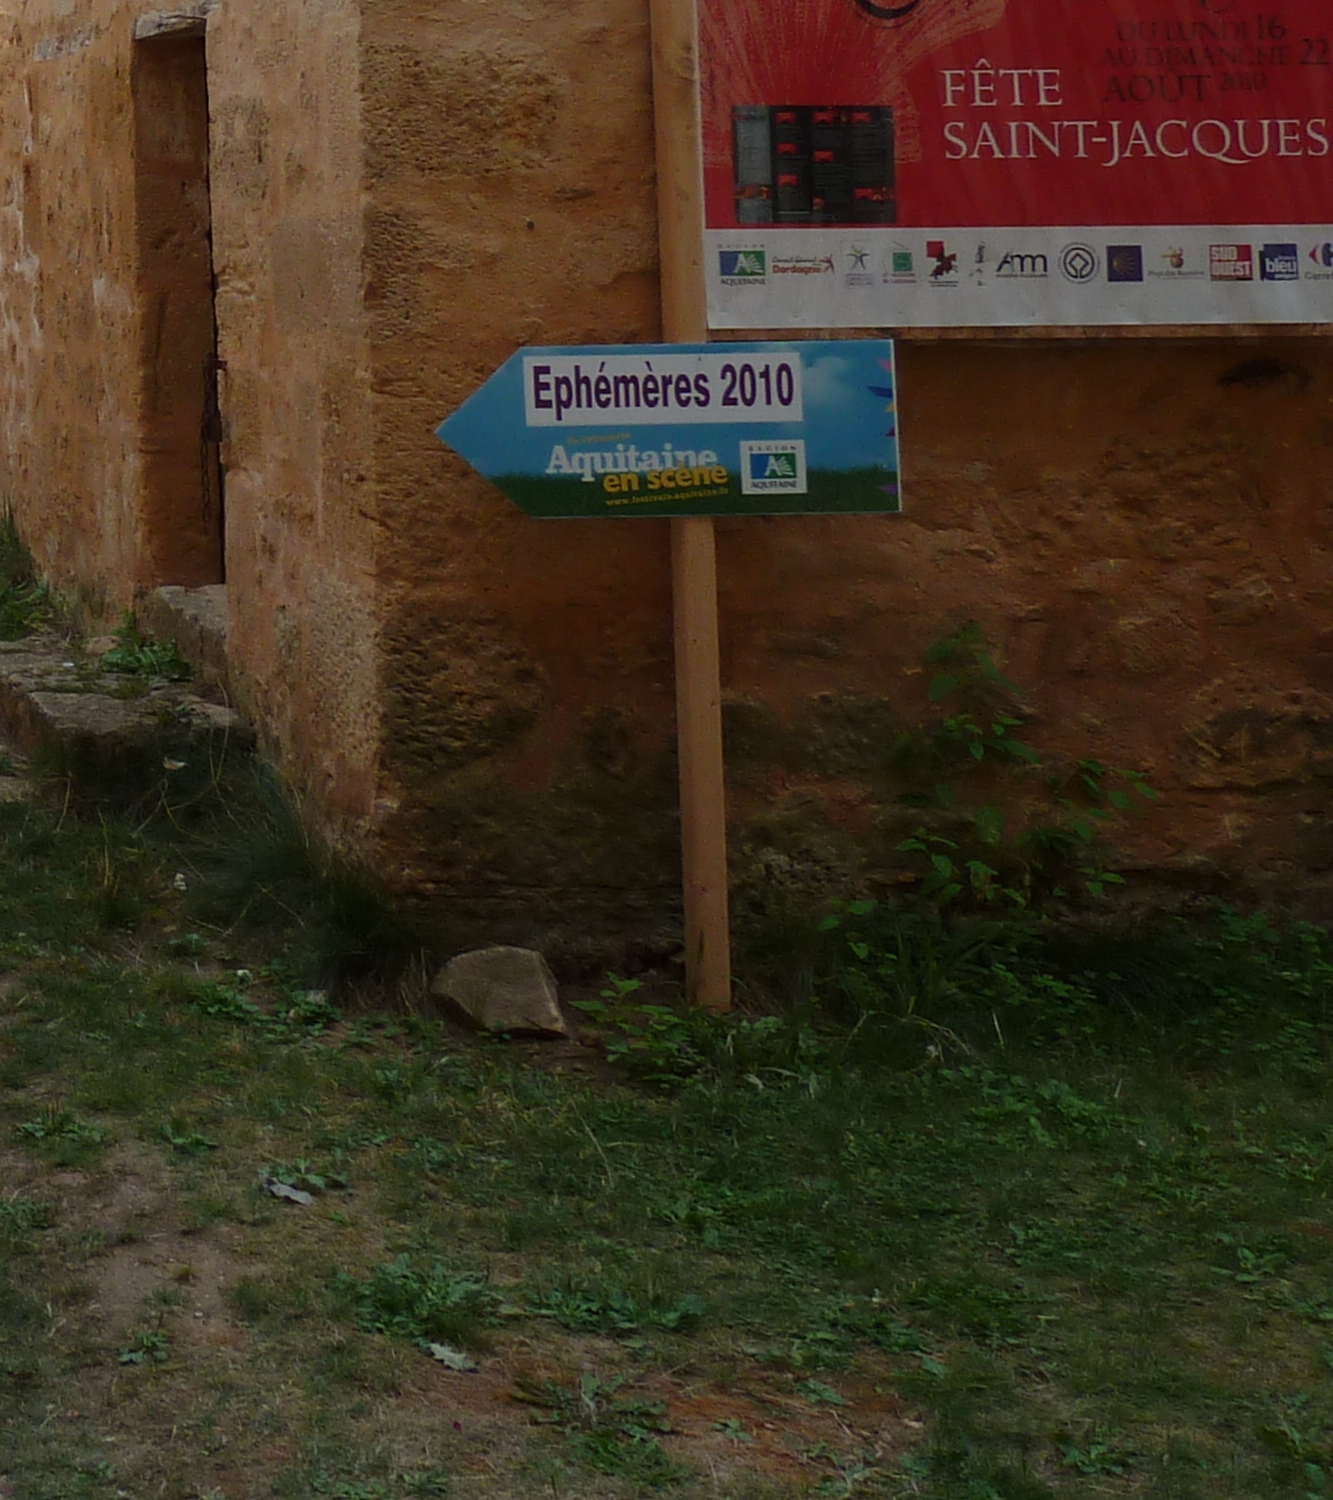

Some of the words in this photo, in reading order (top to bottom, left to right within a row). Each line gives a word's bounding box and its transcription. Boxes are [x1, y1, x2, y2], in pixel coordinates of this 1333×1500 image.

[1115, 21, 1157, 42] DU
[1165, 21, 1248, 41] LUNDI
[1255, 14, 1288, 40] 16
[1101, 47, 1137, 68] AU
[1145, 45, 1289, 67] DIMANCHE
[1299, 37, 1331, 65] 22
[941, 58, 1063, 108] FÊTE
[943, 118, 1330, 167] SAINT-JACQUES
[1211, 246, 1238, 260] SUD
[1265, 257, 1297, 273] bleu
[720, 278, 767, 287] AQUITAINE
[772, 264, 822, 276] Dordogne
[1211, 262, 1252, 276] OUEST
[532, 361, 711, 421] Ephémères
[720, 362, 794, 407] 2010
[545, 442, 719, 483] Aquitaine
[602, 471, 640, 494] en
[647, 459, 730, 491] scène
[751, 480, 797, 490] AQUITAINE
